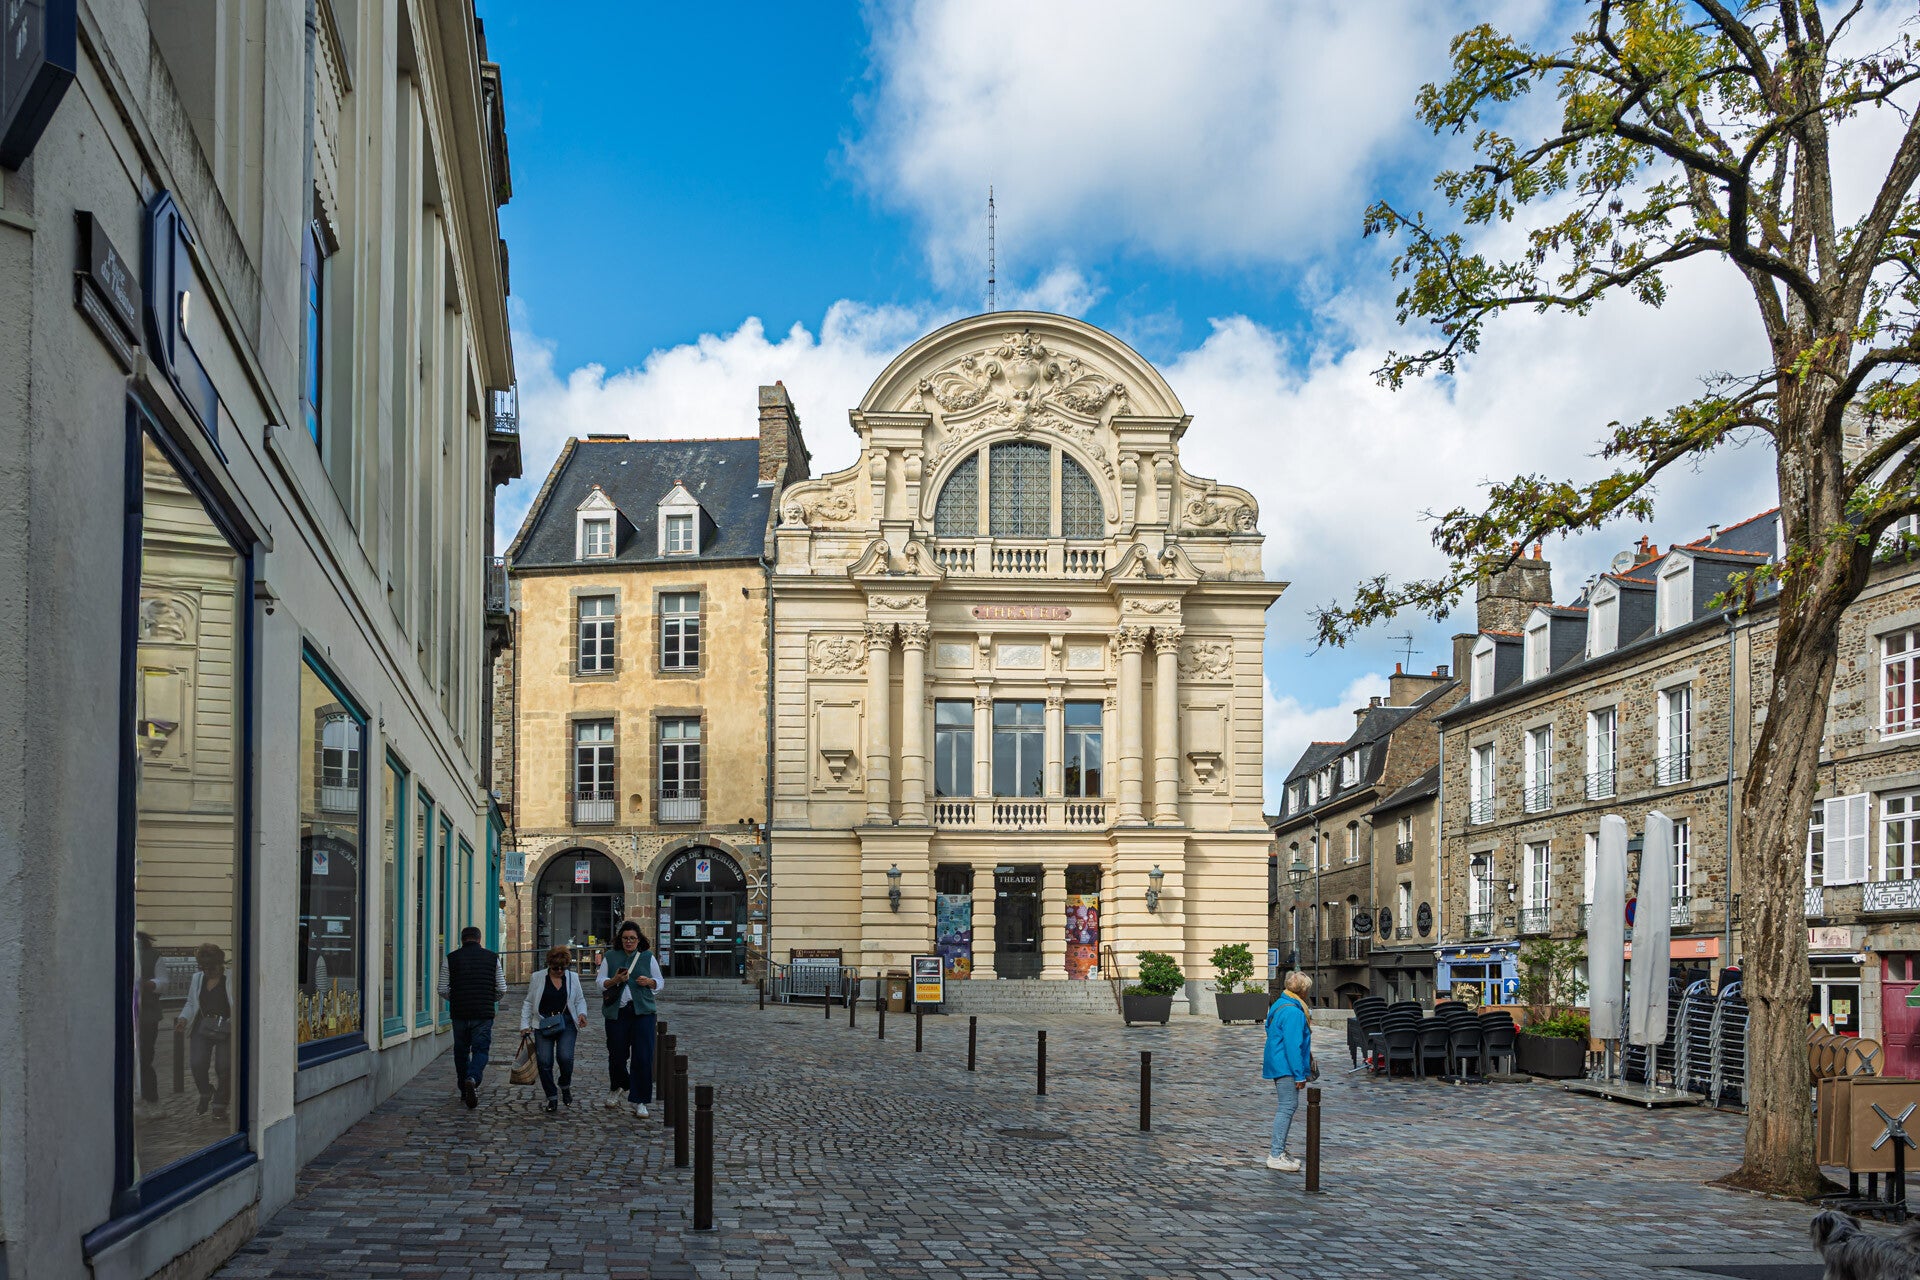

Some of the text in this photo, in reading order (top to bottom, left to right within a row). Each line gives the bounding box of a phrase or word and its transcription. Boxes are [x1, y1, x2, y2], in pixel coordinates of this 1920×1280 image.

[982, 606, 1062, 619] THEATRE
[665, 848, 744, 882] OFFICE DE TOURISME
